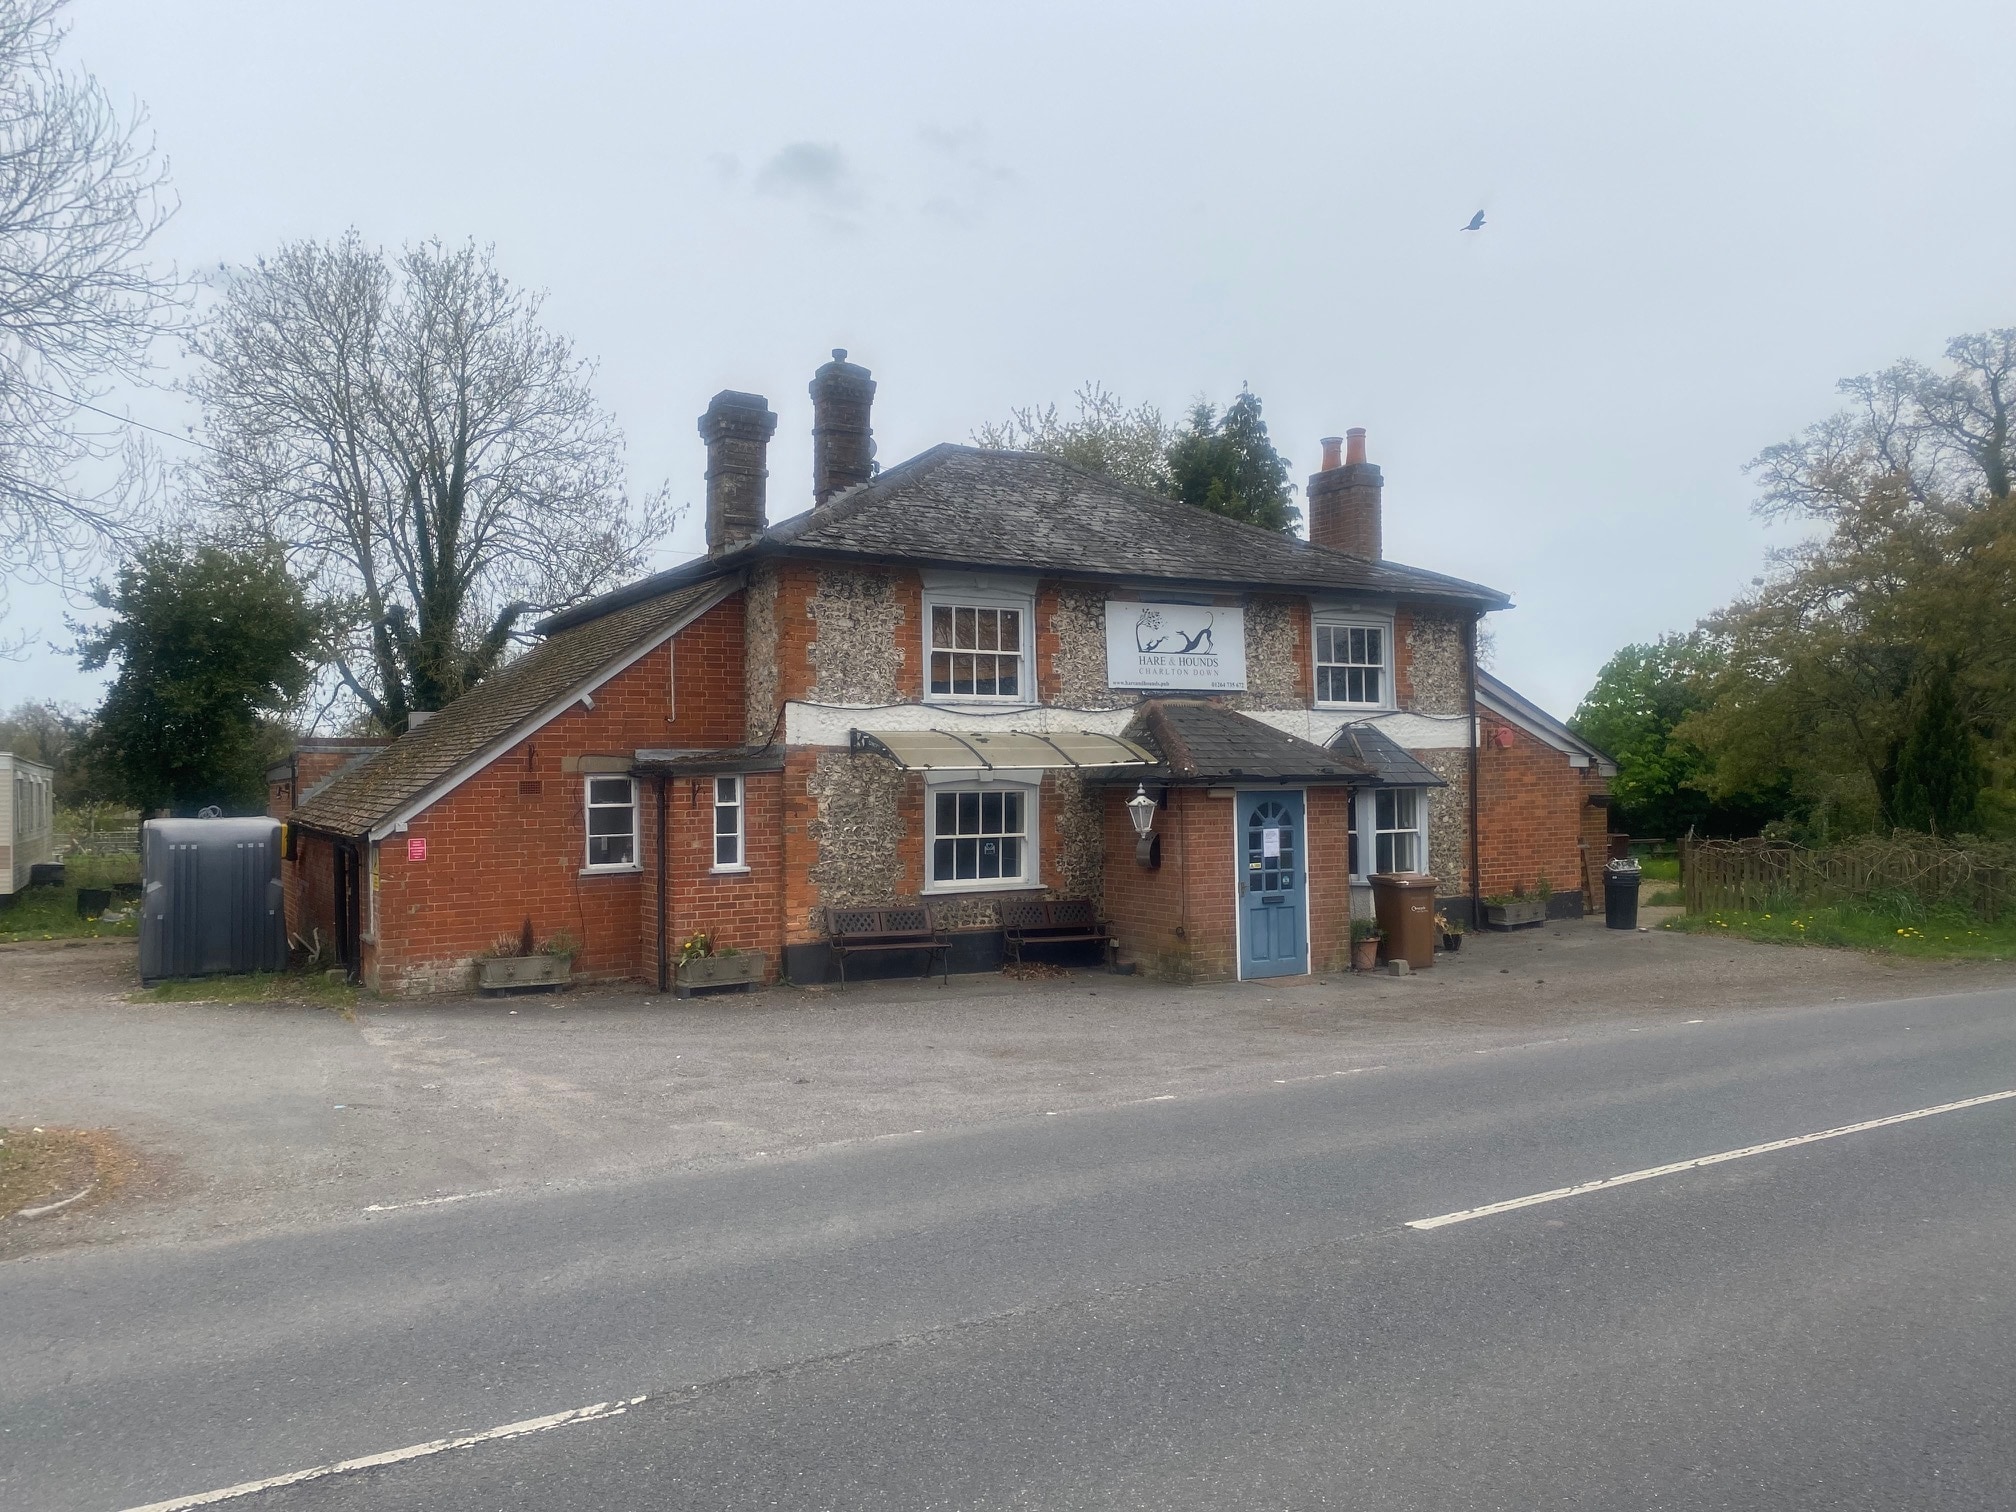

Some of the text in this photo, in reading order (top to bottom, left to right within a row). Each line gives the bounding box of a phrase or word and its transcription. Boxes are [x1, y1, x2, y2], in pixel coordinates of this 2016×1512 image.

[1139, 656, 1219, 667] HARE & HOUNDS
[1139, 668, 1189, 676] CHARLTON
